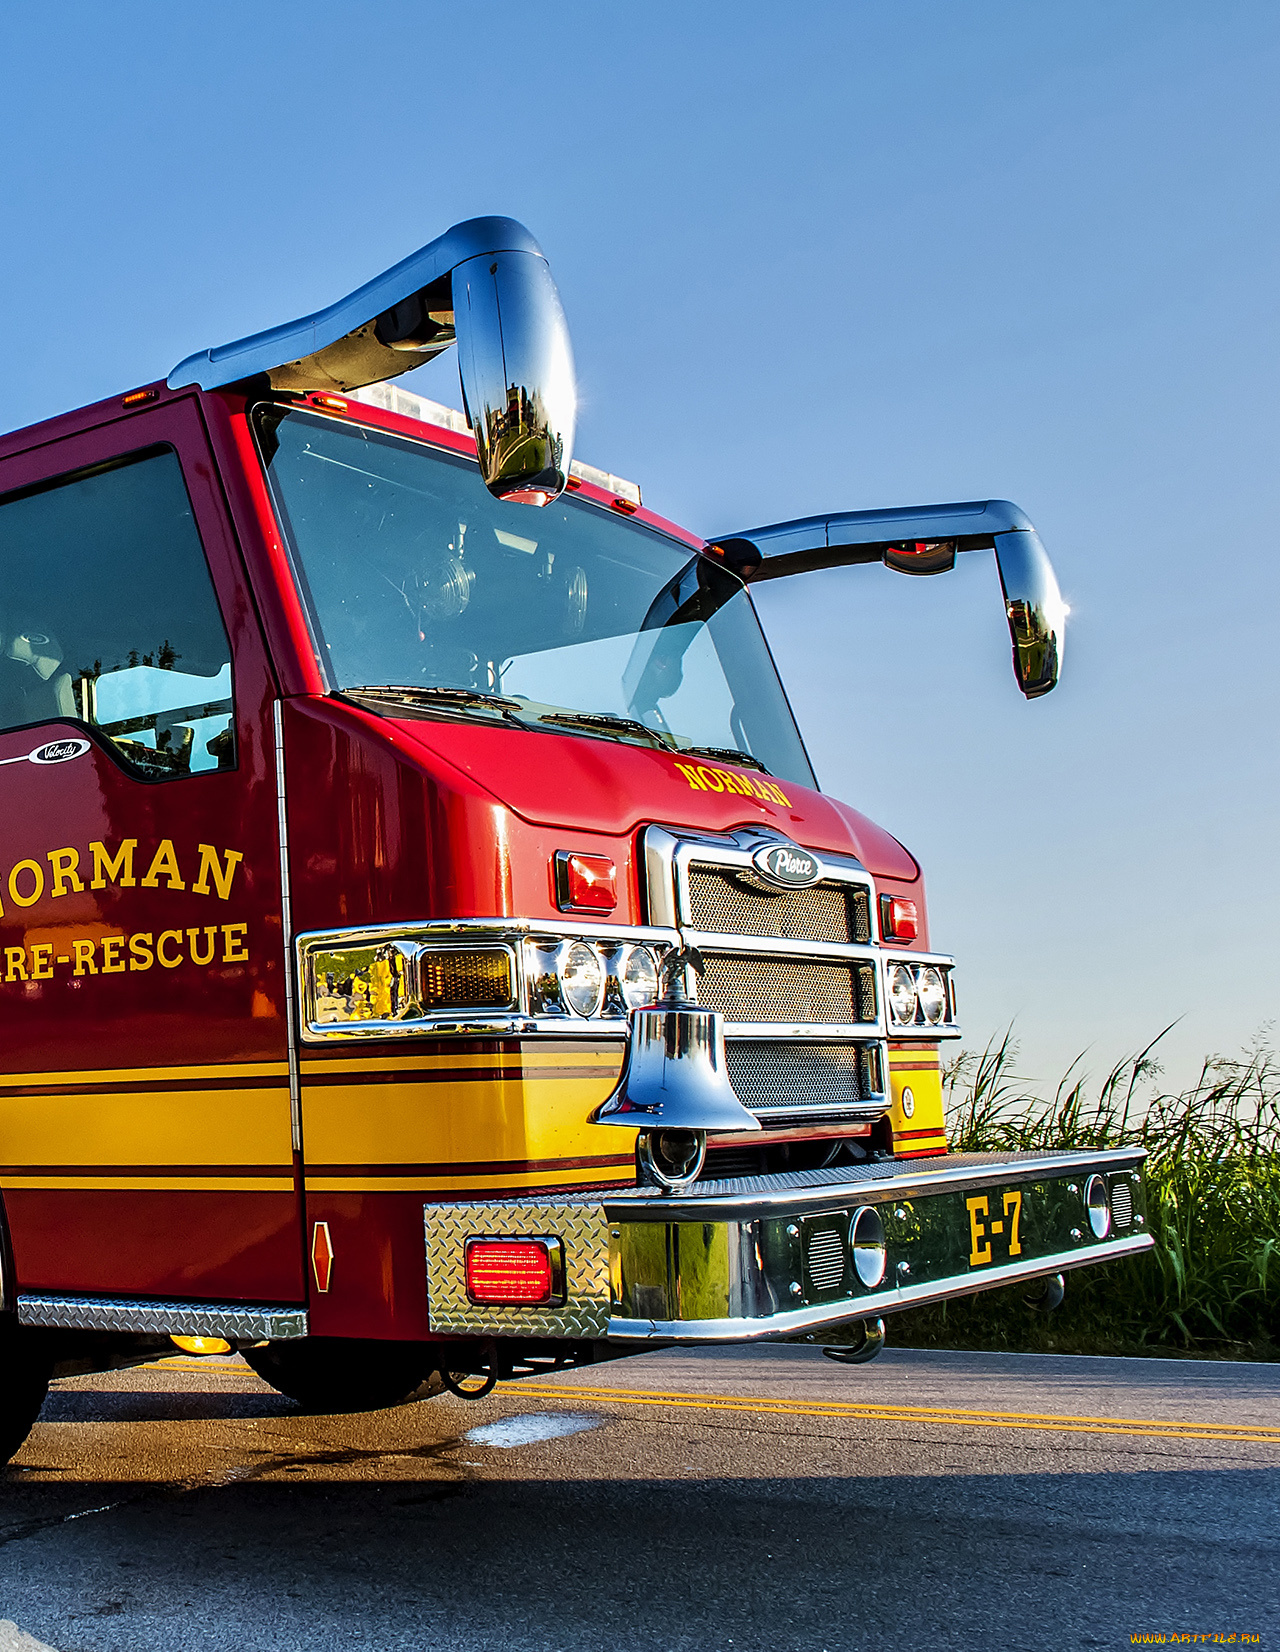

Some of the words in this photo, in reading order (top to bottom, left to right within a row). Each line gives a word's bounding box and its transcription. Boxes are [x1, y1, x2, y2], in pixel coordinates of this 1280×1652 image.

[45, 743, 76, 759] Velocity
[674, 762, 793, 809] NORMAN
[775, 849, 812, 876] Pierce
[966, 1190, 1022, 1267] E-7
